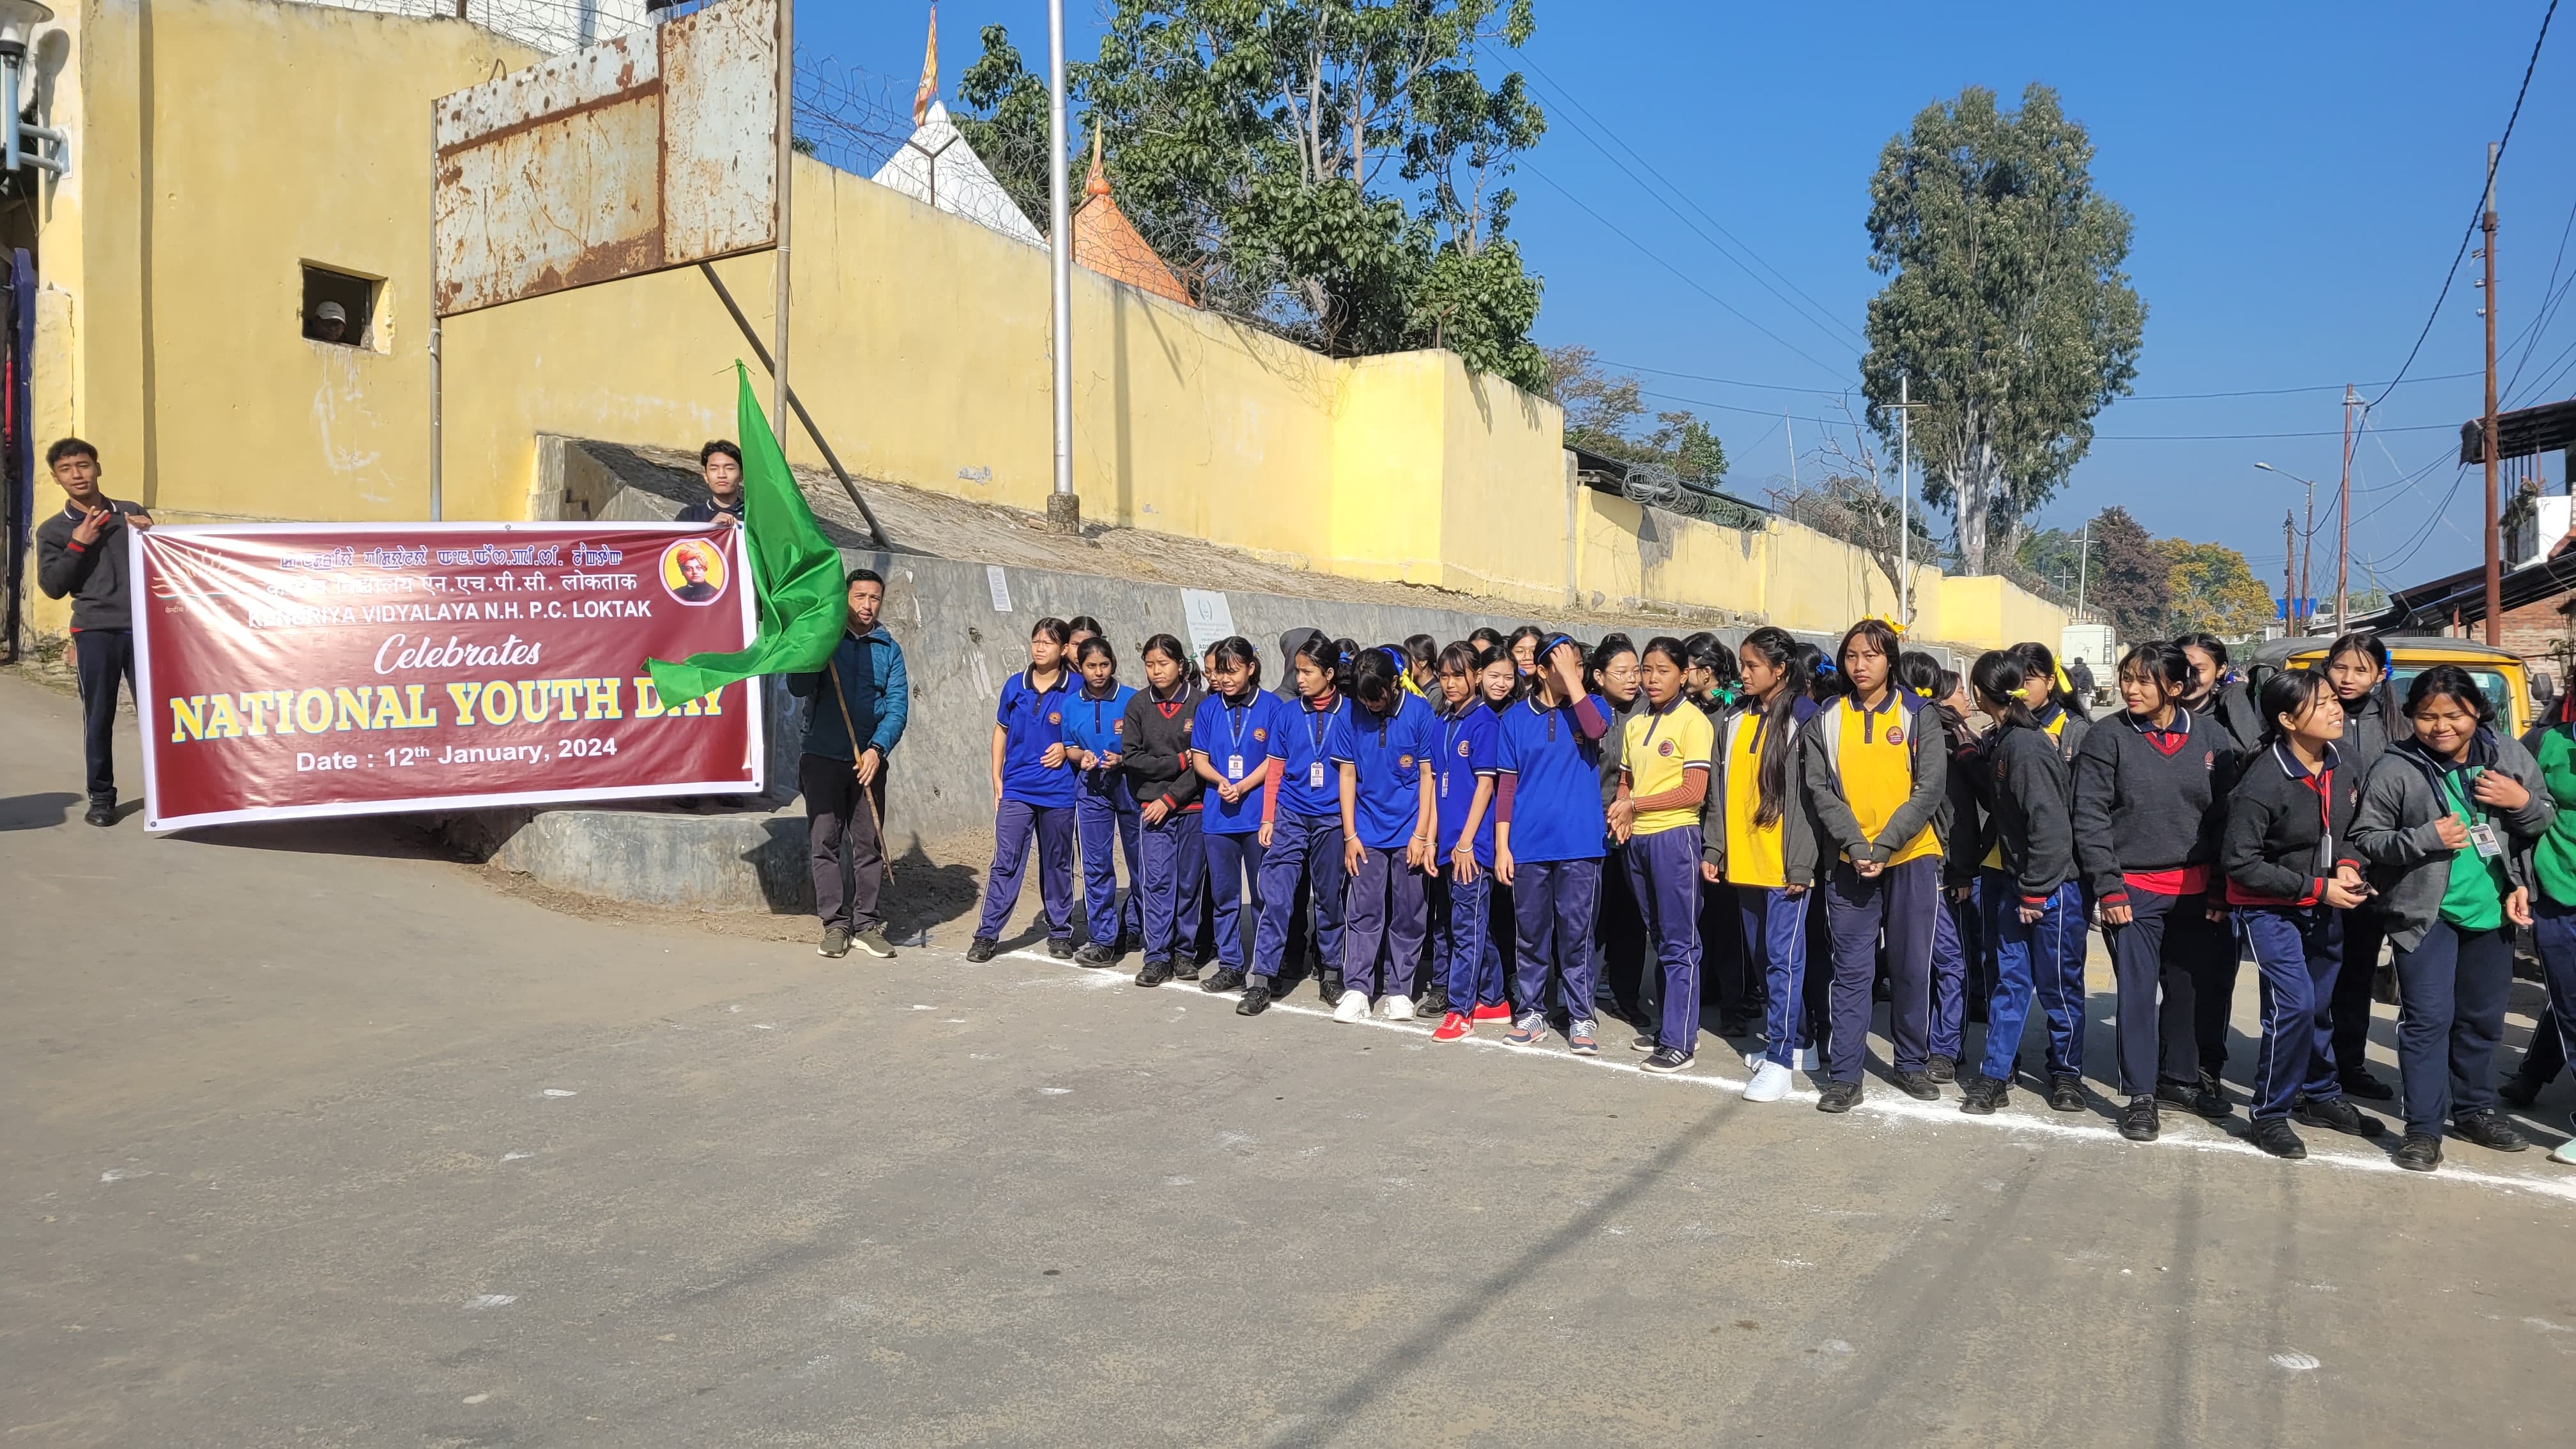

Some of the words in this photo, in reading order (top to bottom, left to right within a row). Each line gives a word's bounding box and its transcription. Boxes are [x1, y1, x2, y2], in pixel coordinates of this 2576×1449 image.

[422, 572, 553, 595] एन.एच.पी.सी.
[559, 569, 638, 592] लोकताक
[361, 602, 479, 622] VIDYALAYA
[485, 601, 524, 620] N.H.
[529, 601, 567, 619] P.C.
[572, 599, 652, 619] LOKTAK
[374, 634, 541, 675] Celebrates
[171, 684, 437, 742] NATIONAL
[447, 677, 622, 726] YOUTH
[296, 751, 358, 772] Date
[384, 745, 431, 768] 12th
[437, 744, 550, 765] January,
[558, 737, 618, 758] 2024
